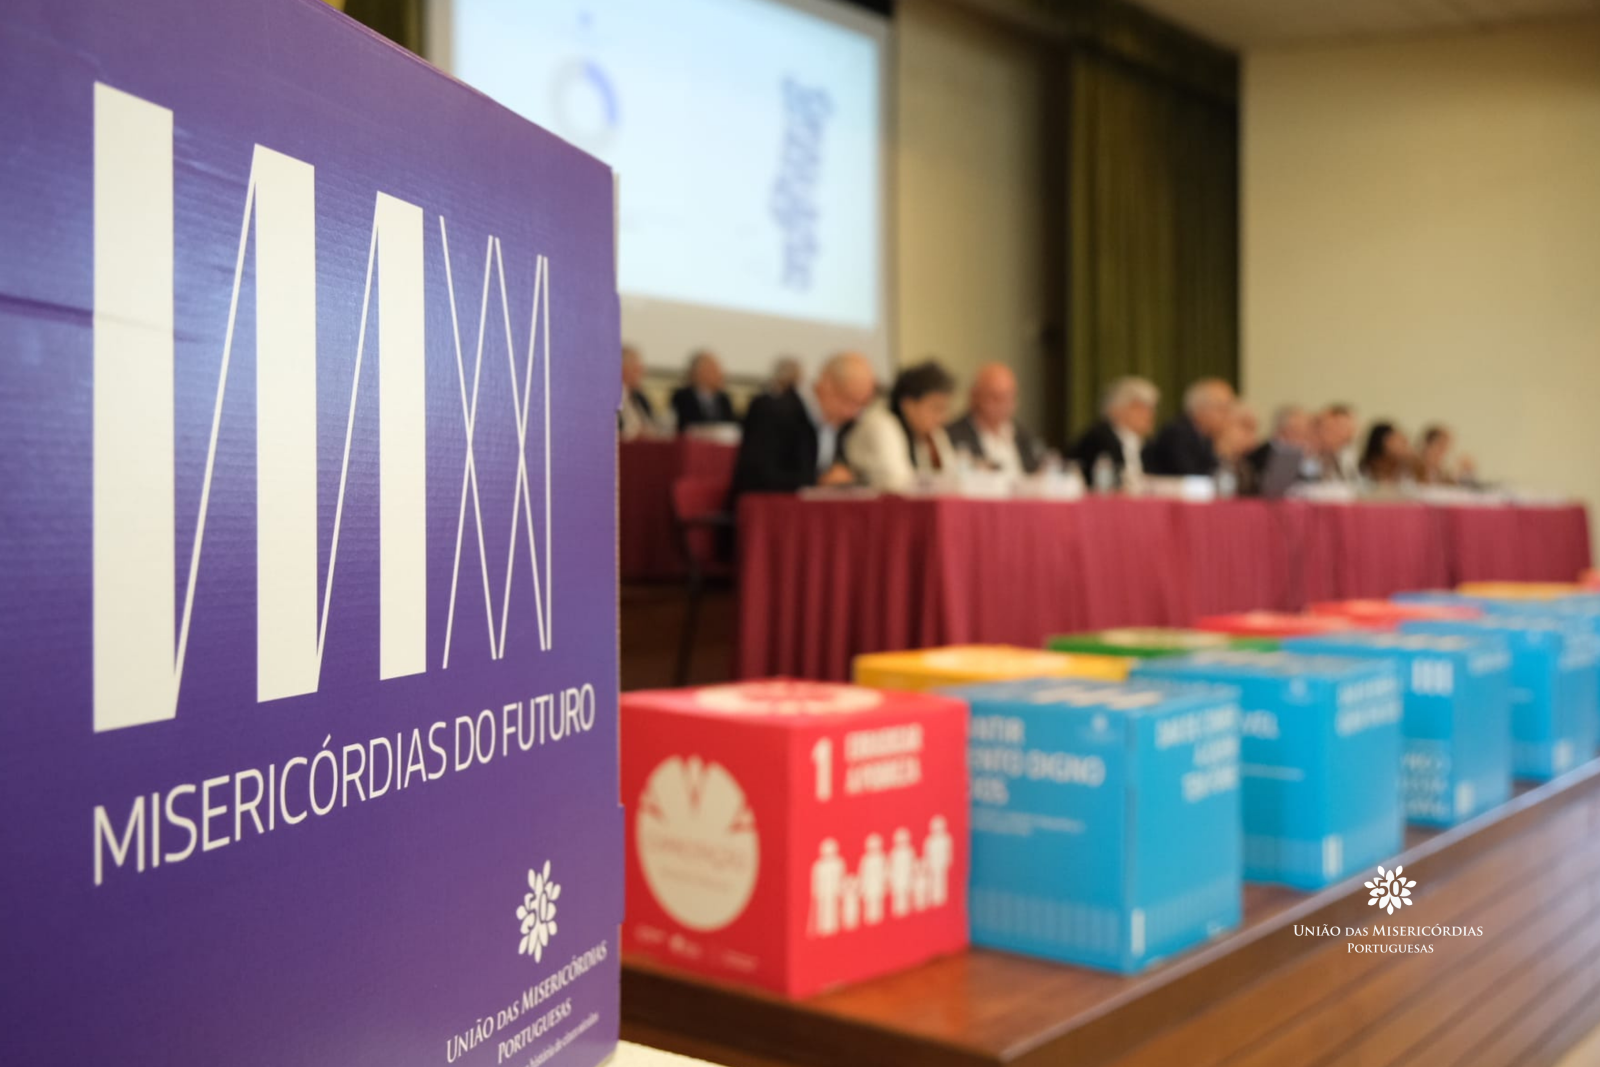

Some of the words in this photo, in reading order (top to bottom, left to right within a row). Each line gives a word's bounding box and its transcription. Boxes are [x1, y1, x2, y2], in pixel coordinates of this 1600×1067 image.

[94, 721, 447, 886] MISERICÓRDIAS
[455, 709, 496, 772] DO
[502, 683, 596, 757] FUTURO
[811, 736, 833, 802] 1
